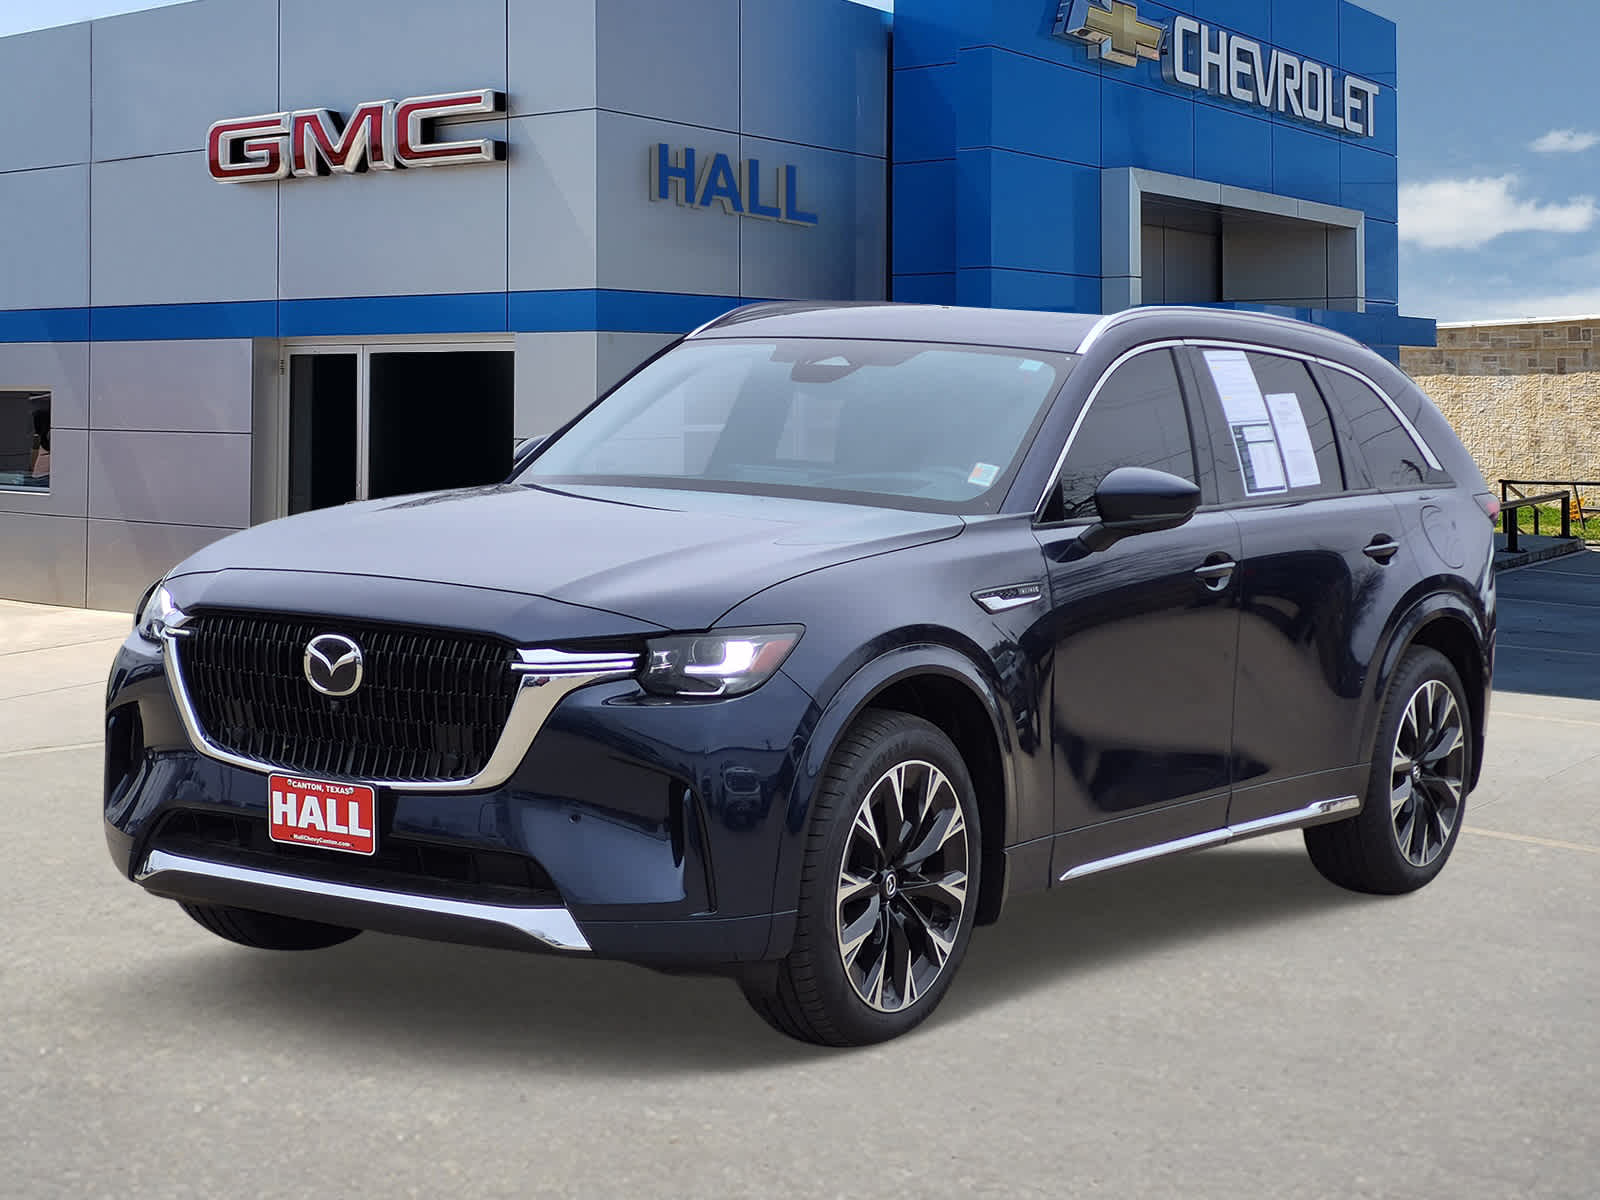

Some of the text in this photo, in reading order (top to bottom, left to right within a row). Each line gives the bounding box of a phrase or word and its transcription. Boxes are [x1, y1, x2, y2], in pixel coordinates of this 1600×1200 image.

[1173, 15, 1380, 137] CHEVROLET
[208, 88, 506, 184] GMC
[650, 143, 818, 226] HALL
[272, 791, 371, 838] HALL
[292, 781, 350, 795] CANTON, TEXAS
